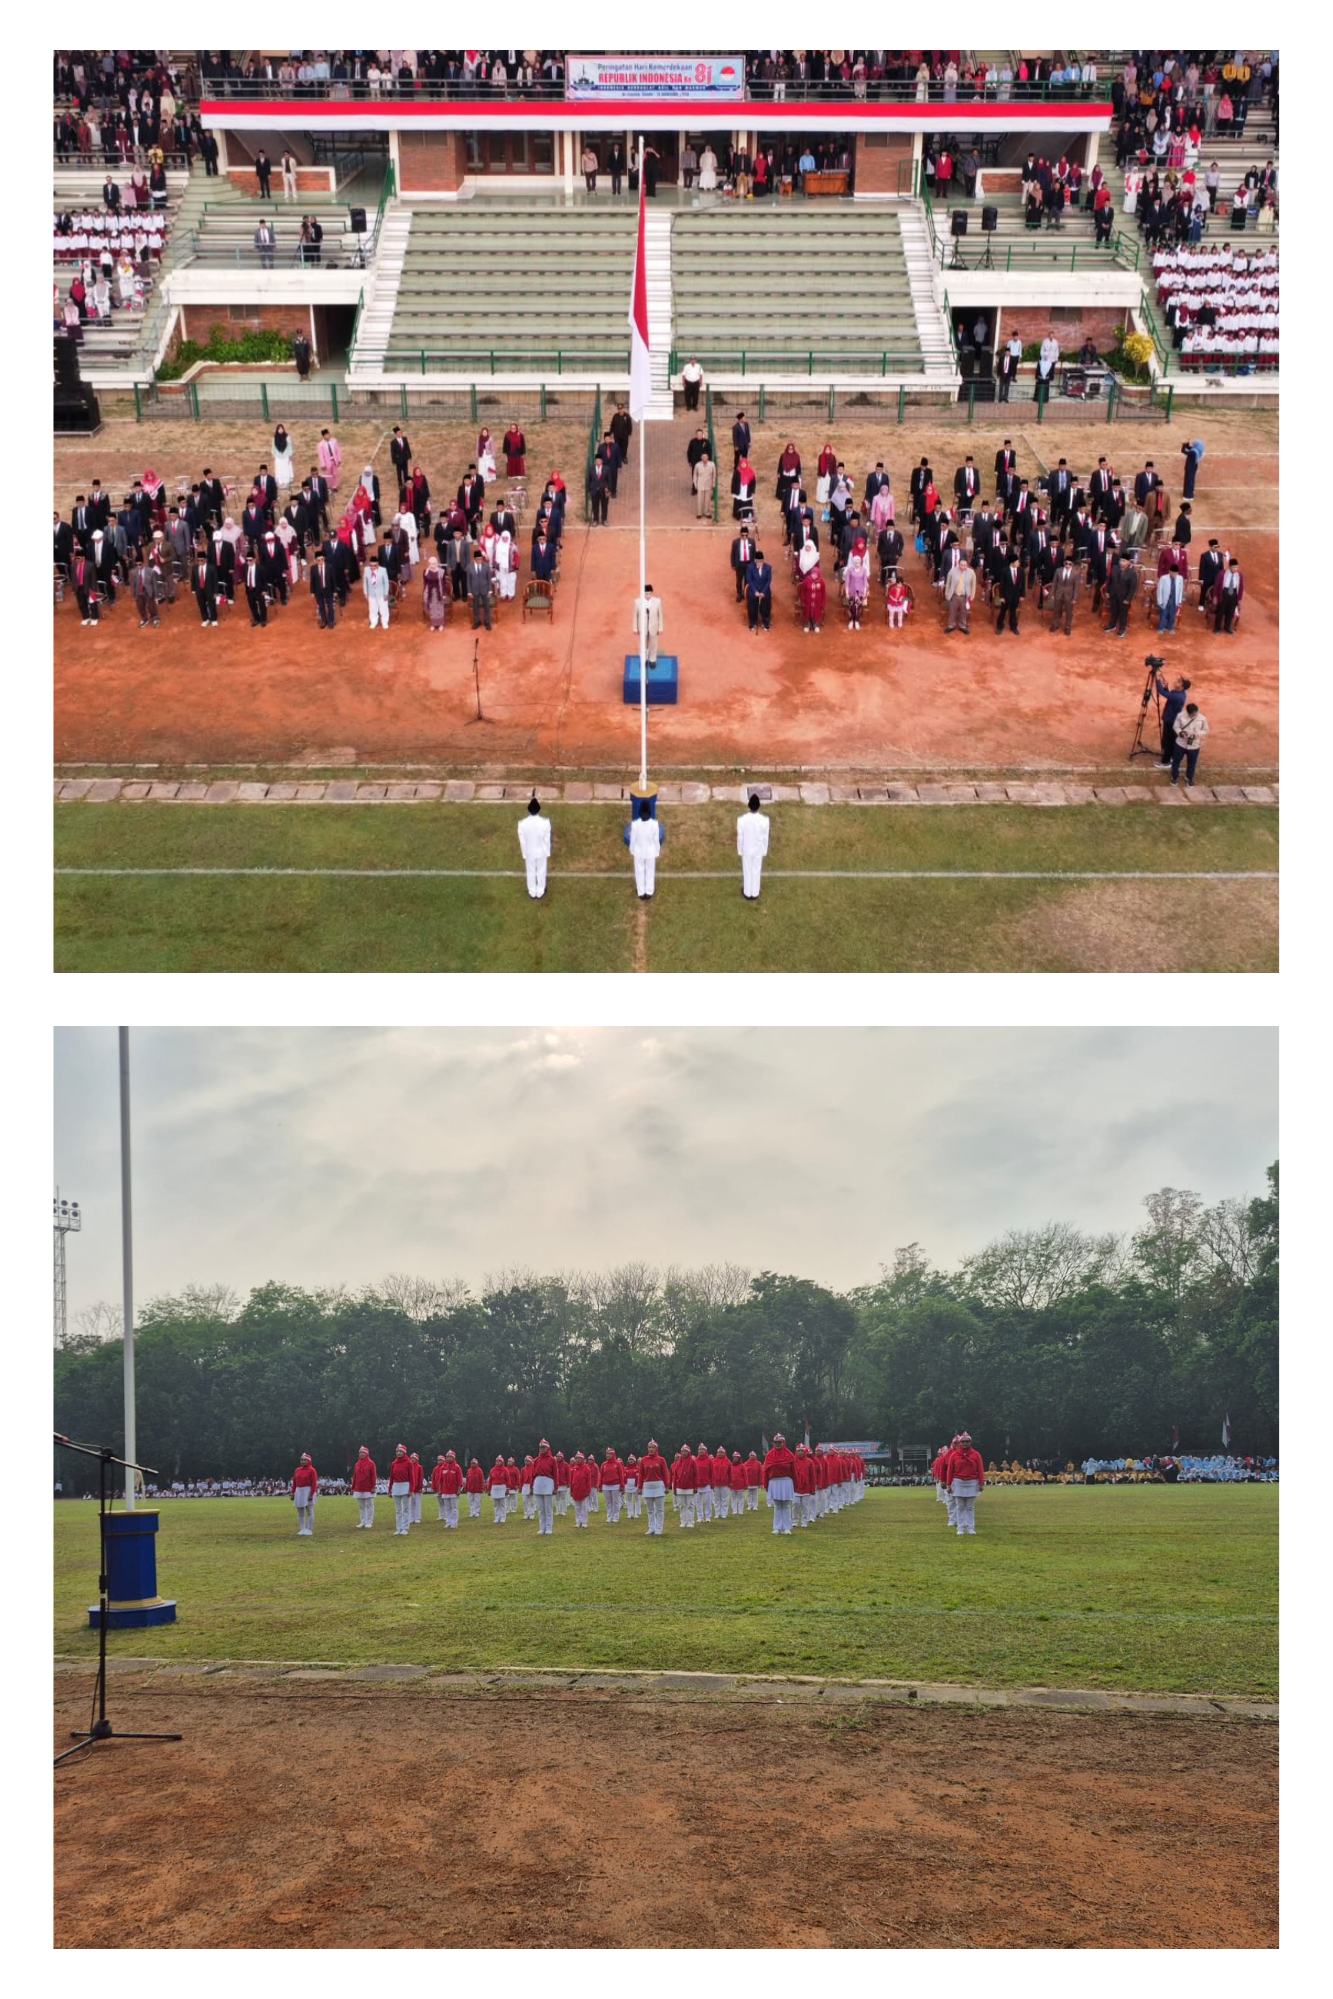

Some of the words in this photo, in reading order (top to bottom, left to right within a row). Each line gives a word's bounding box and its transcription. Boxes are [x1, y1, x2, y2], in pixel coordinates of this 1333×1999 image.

[597, 63, 632, 72] Peringatan
[598, 73, 638, 83] REPUBLIK
[639, 73, 683, 83] INDONESIA
[694, 63, 713, 85] 81
